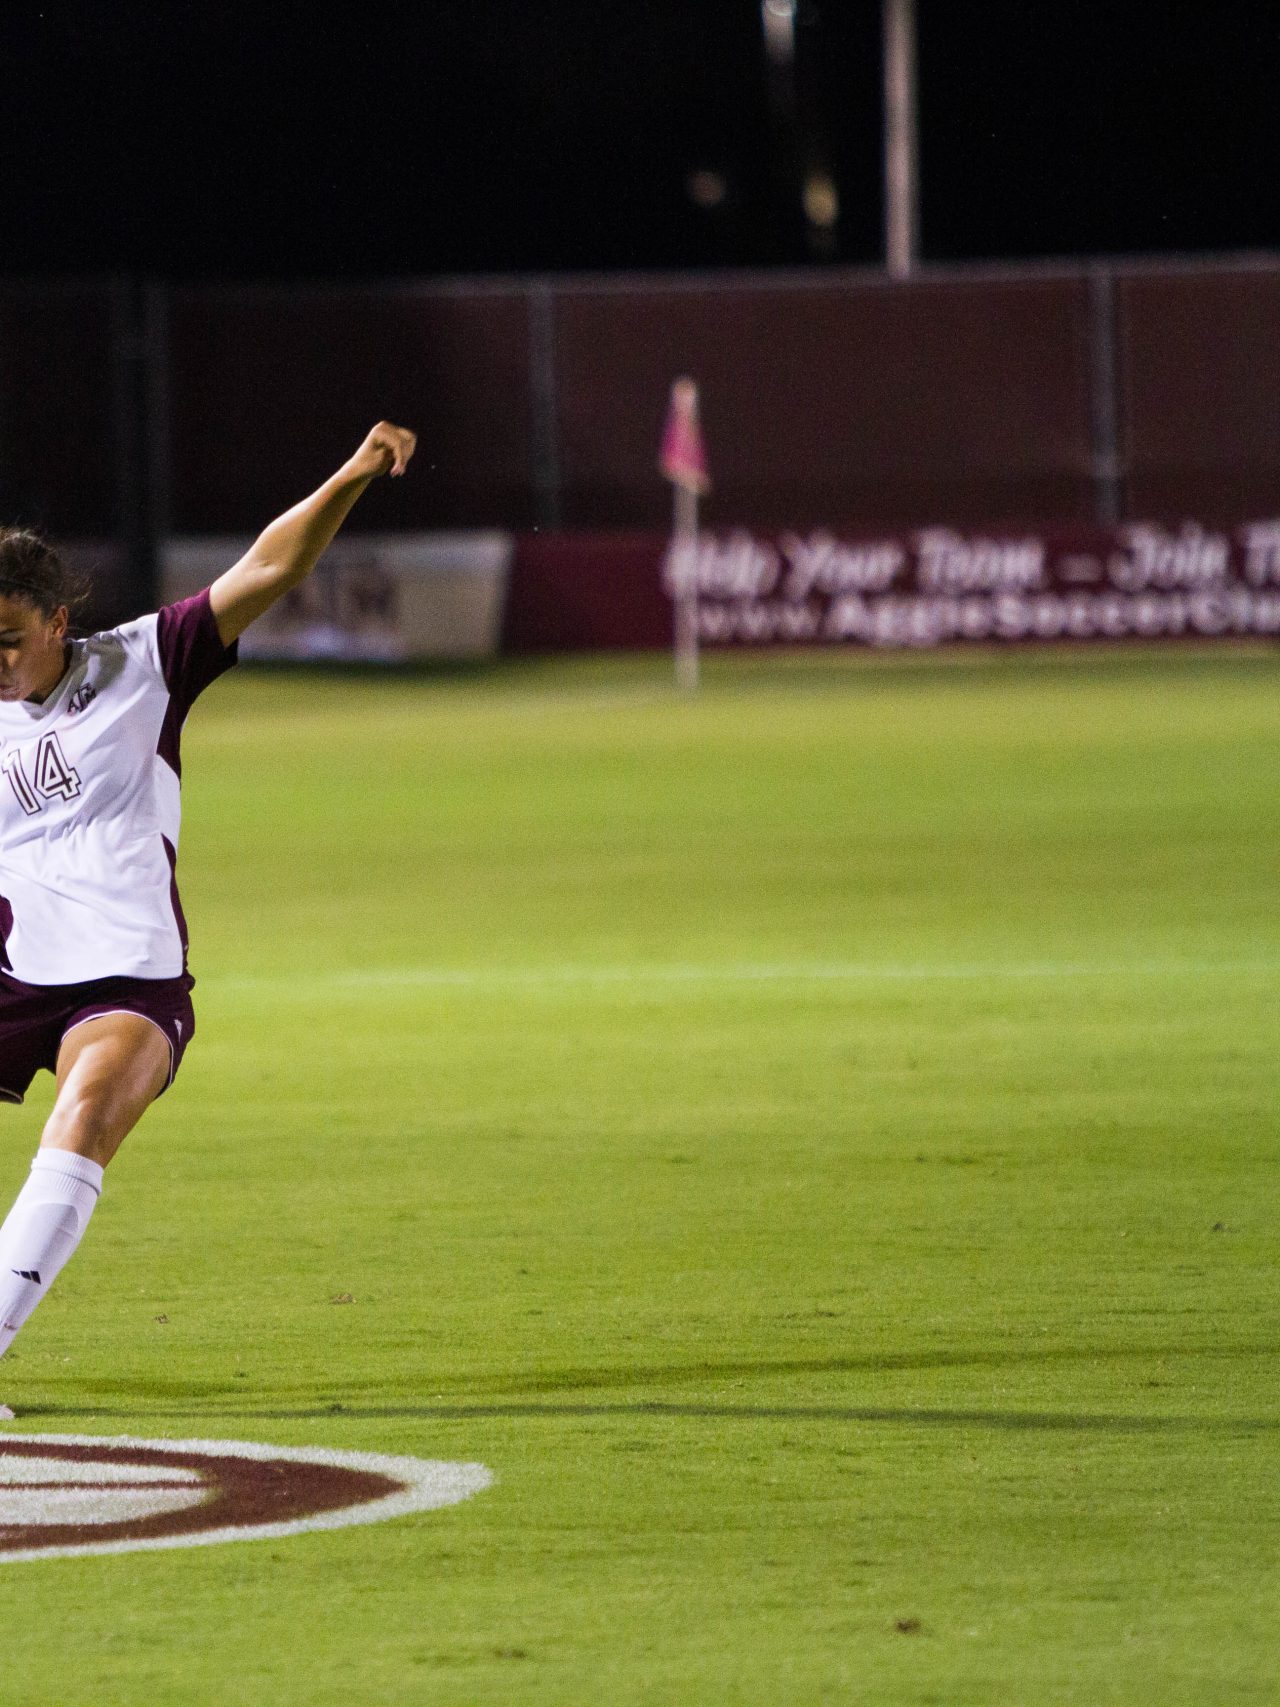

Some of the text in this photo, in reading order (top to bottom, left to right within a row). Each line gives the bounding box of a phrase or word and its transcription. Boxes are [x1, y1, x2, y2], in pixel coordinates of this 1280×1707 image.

[780, 530, 904, 600] Your
[917, 527, 1044, 590] Team
[1108, 524, 1228, 590] Join
[1, 730, 82, 816] 14
